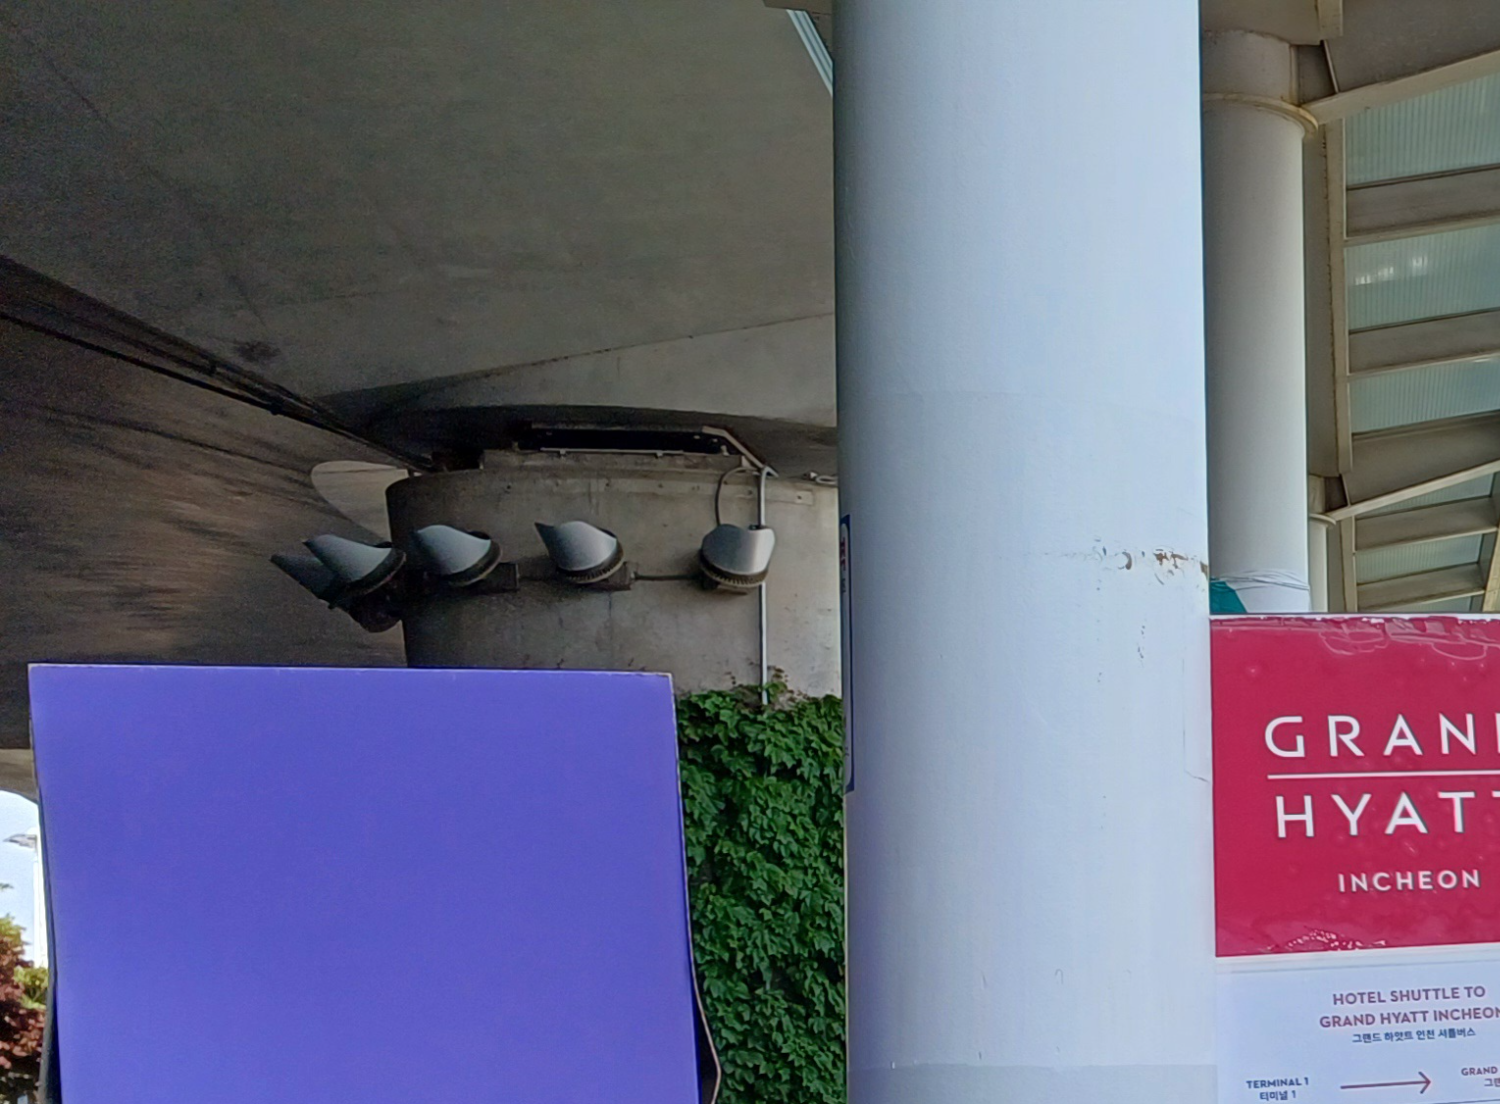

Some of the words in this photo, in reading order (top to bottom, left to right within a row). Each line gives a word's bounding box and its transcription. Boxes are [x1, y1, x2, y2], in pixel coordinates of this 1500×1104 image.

[1338, 869, 1481, 893] INCHEON
[1333, 991, 1386, 1006] HOTEL
[1390, 987, 1461, 1003] SHUTTLE
[1464, 985, 1486, 998] TO
[1319, 1013, 1376, 1028] GRAND
[1380, 1010, 1429, 1025] HYATT
[1352, 1033, 1382, 1044] 그랜드
[1384, 1031, 1414, 1042] 하얏트
[1416, 1029, 1435, 1040] 인천
[1438, 1027, 1476, 1039] 셔틀버스
[1461, 1066, 1498, 1077] GRAND
[1246, 1078, 1302, 1089] TERMINAL
[1304, 1077, 1309, 1085] 1
[1259, 1091, 1288, 1101] 터미널
[1292, 1090, 1296, 1098] 1
